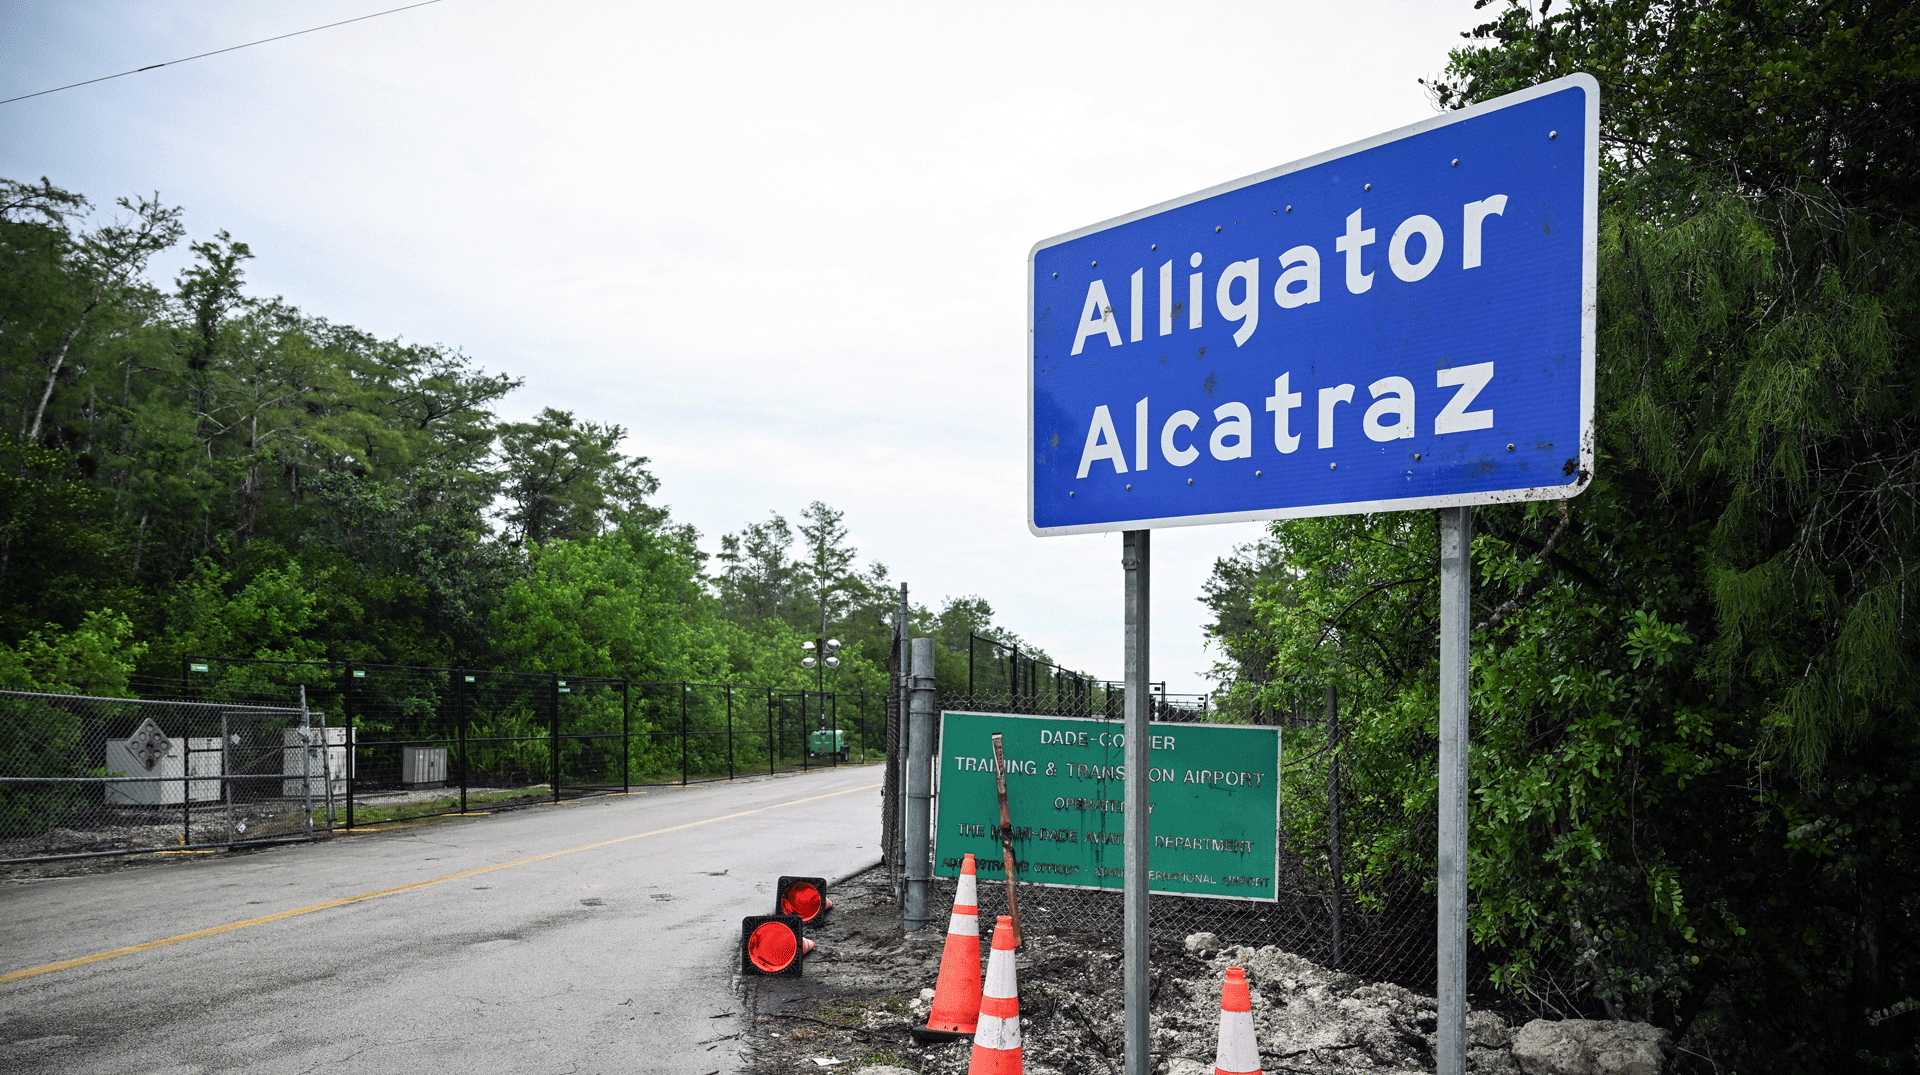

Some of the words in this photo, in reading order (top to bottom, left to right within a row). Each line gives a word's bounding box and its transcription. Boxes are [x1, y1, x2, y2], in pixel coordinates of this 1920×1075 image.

[1070, 193, 1509, 356] Alligator
[1076, 361, 1494, 479] Alcatraz
[1040, 729, 1176, 751] DADE-COIER
[954, 756, 1037, 775] TRAIING
[1045, 762, 1057, 776] &
[1066, 763, 1175, 783] TRANSON
[1183, 769, 1265, 787] AIRPORT
[957, 823, 985, 837] THE
[1084, 831, 1125, 845] AVIAT
[1155, 835, 1255, 853] DEPARTMENT
[1033, 862, 1080, 875] OFFICES
[1094, 867, 1125, 878] MIAM
[1148, 870, 1217, 884] ERNATIONAL
[1221, 875, 1271, 888] AIRPORT
